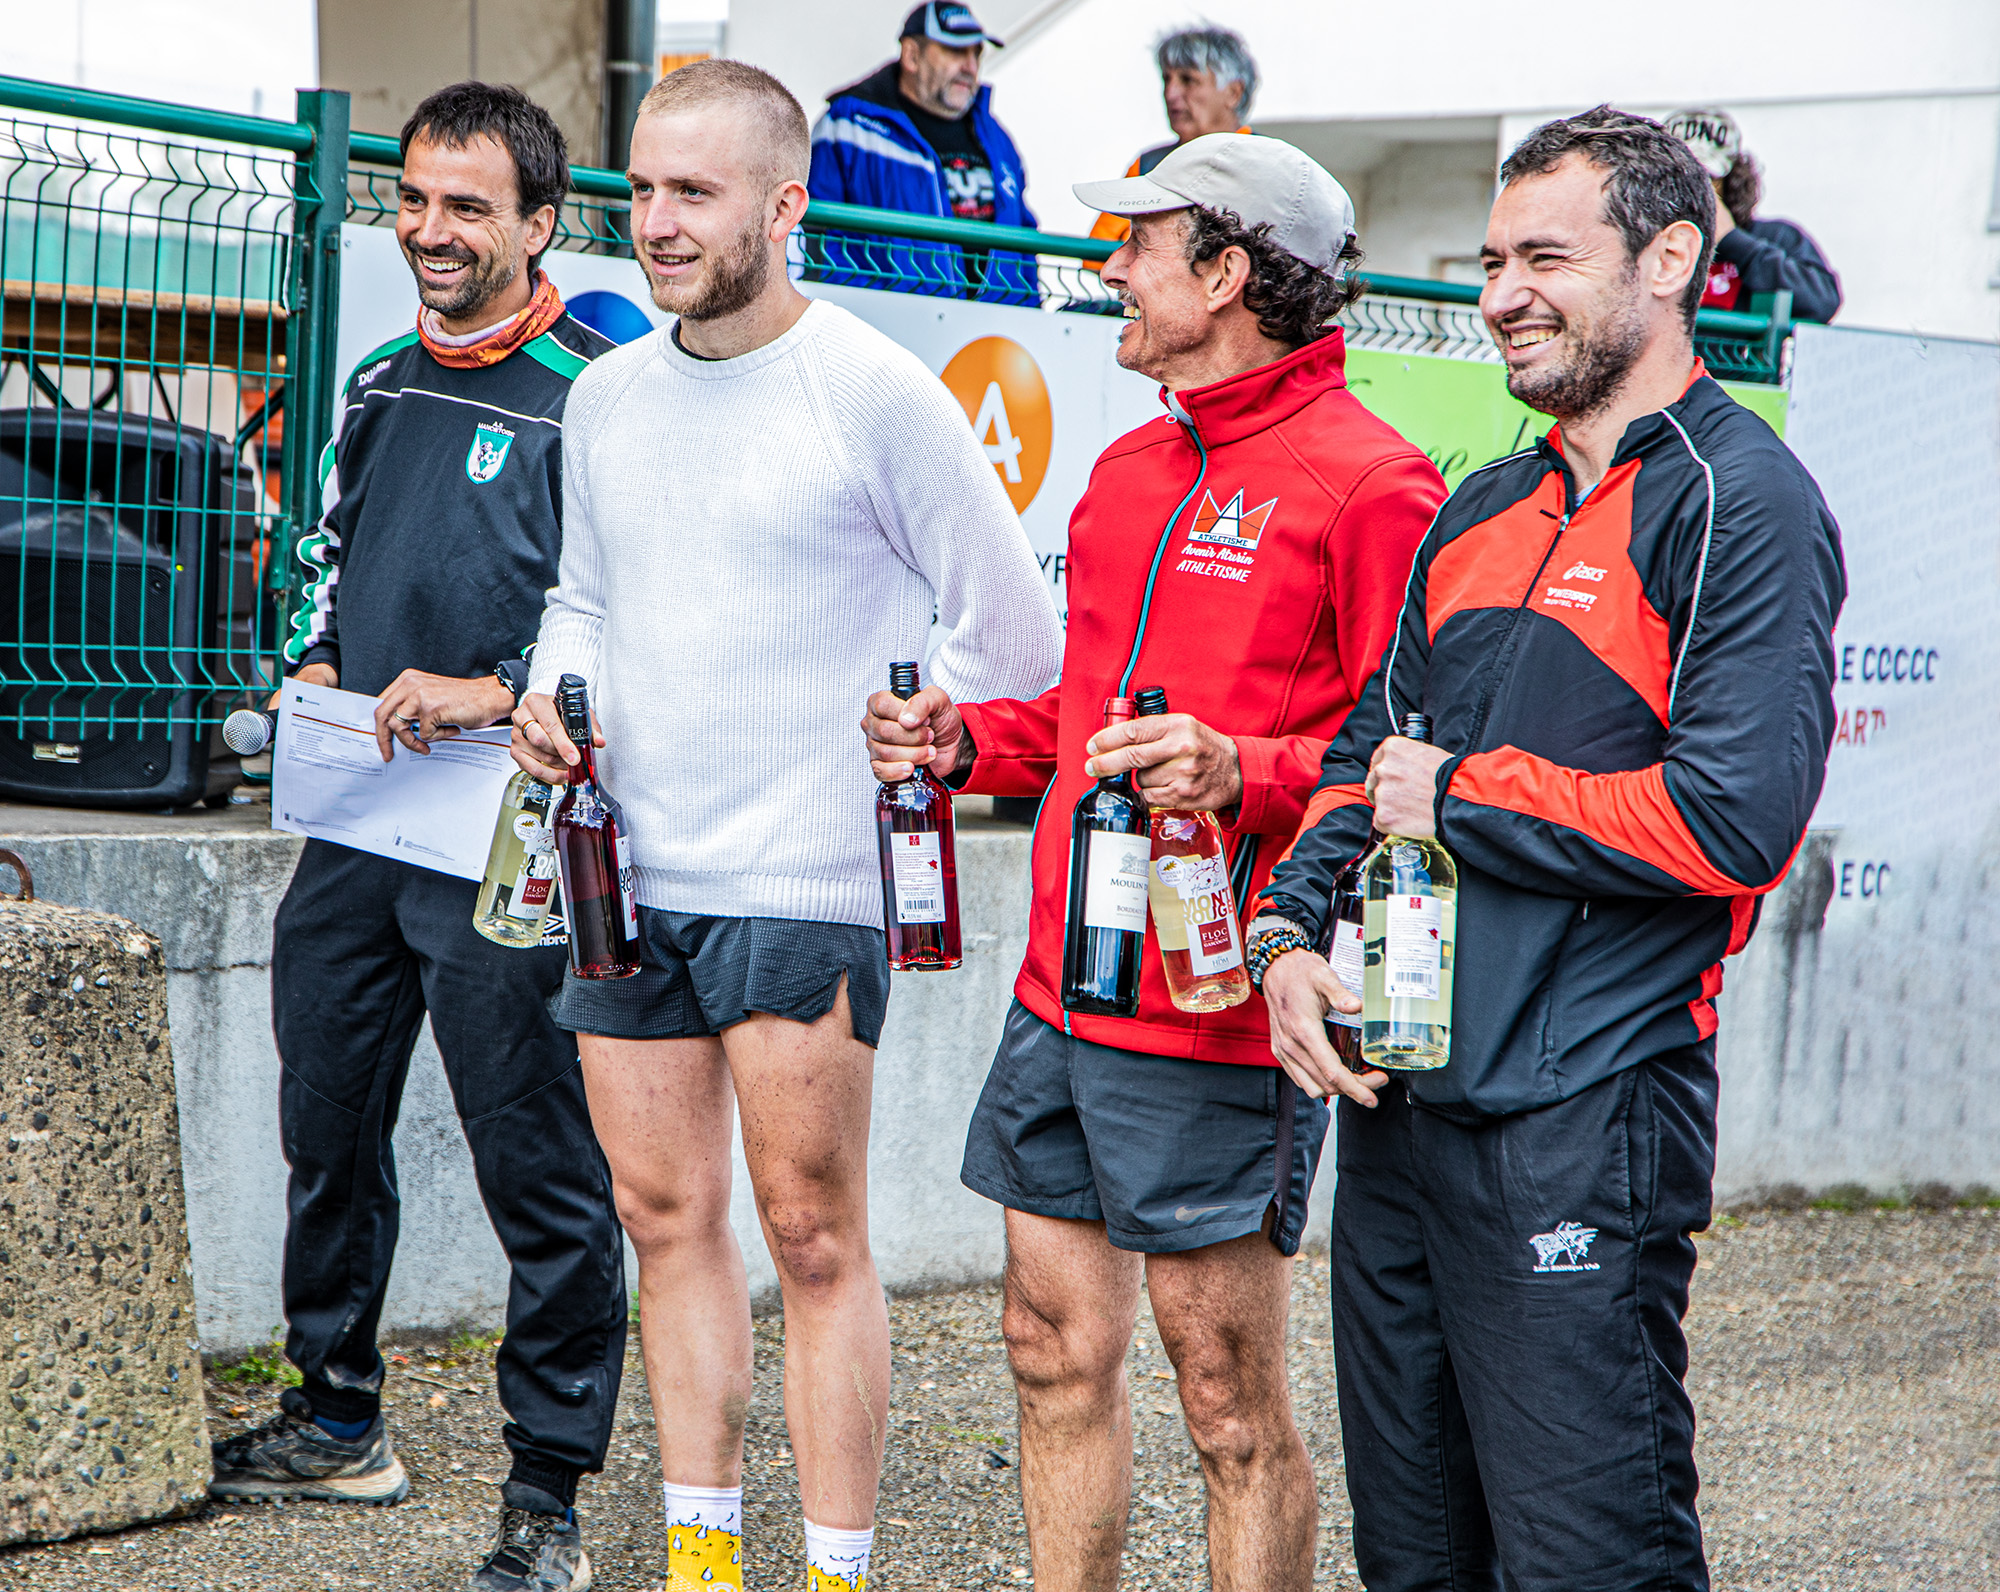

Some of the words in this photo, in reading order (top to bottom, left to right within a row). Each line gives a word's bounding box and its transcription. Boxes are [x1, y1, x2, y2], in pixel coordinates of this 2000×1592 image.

[1118, 198, 1162, 206] FORCLAZ
[973, 381, 1023, 483] A
[1181, 542, 1217, 559] Avenir
[1175, 560, 1252, 583] ATHLÉTISME
[568, 728, 589, 736] FLOC
[527, 885, 550, 893] FLOC
[1110, 878, 1144, 890] MOULIN
[1180, 887, 1231, 912] MONT
[1182, 899, 1235, 926] ROUGE
[1202, 927, 1228, 941] FLOC
[1203, 937, 1229, 948] GASCOGNE
